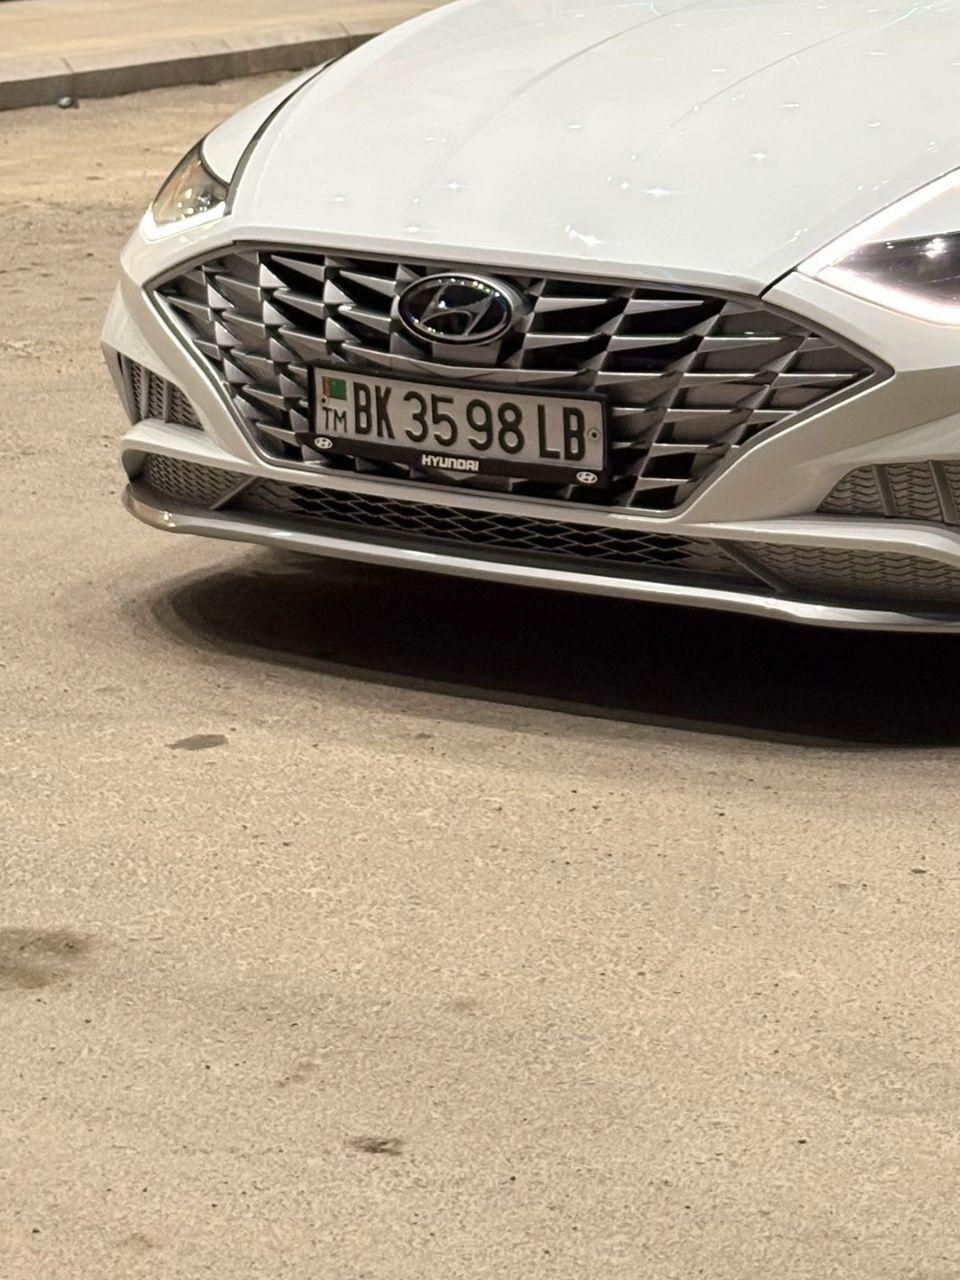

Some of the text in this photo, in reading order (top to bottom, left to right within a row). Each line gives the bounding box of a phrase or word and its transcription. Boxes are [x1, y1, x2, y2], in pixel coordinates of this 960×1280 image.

[322, 406, 347, 432] TM
[353, 381, 586, 461] BK 3598 LB
[421, 453, 479, 471] HYUNDAI
